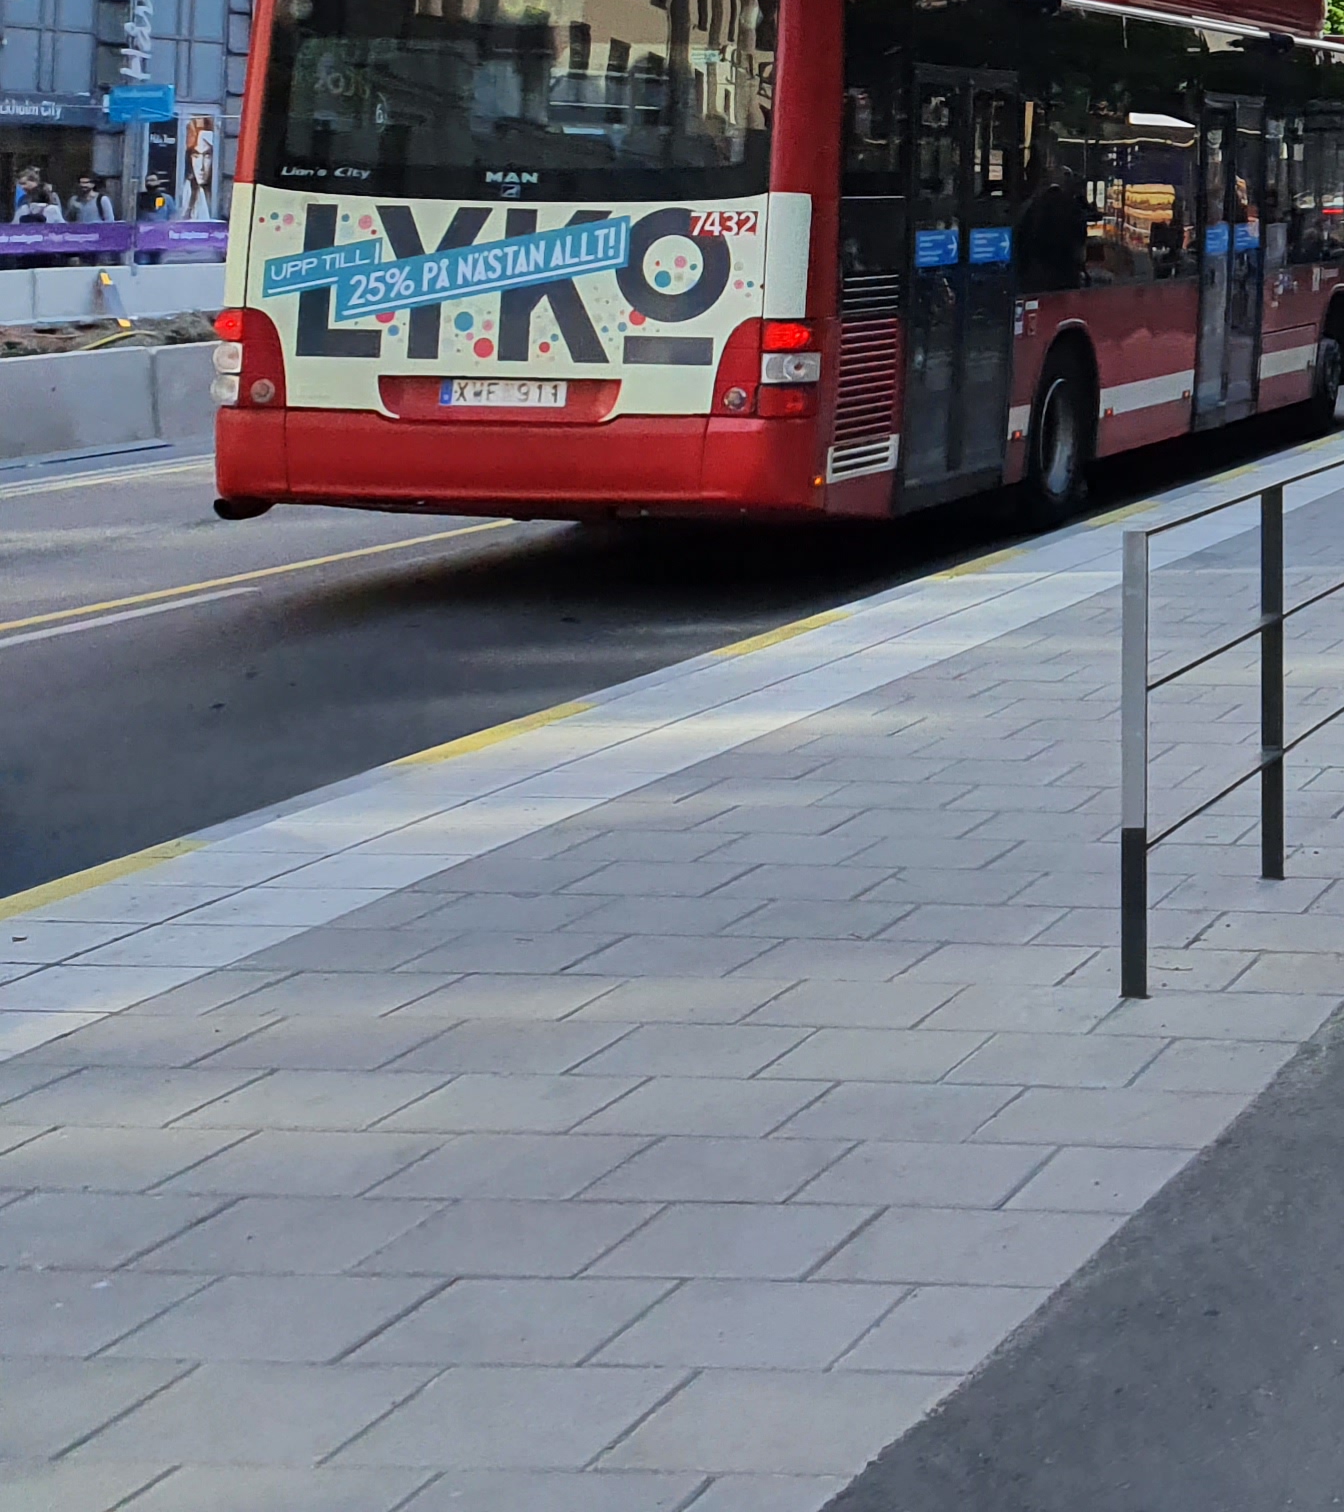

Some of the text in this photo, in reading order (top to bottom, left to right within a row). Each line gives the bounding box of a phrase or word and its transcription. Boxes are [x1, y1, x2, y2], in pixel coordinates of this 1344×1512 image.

[485, 171, 539, 184] MAN
[691, 211, 757, 236] 7432
[271, 258, 317, 282] UPP
[348, 223, 616, 306] 25% PÅ NÄSTAN ALLT!
